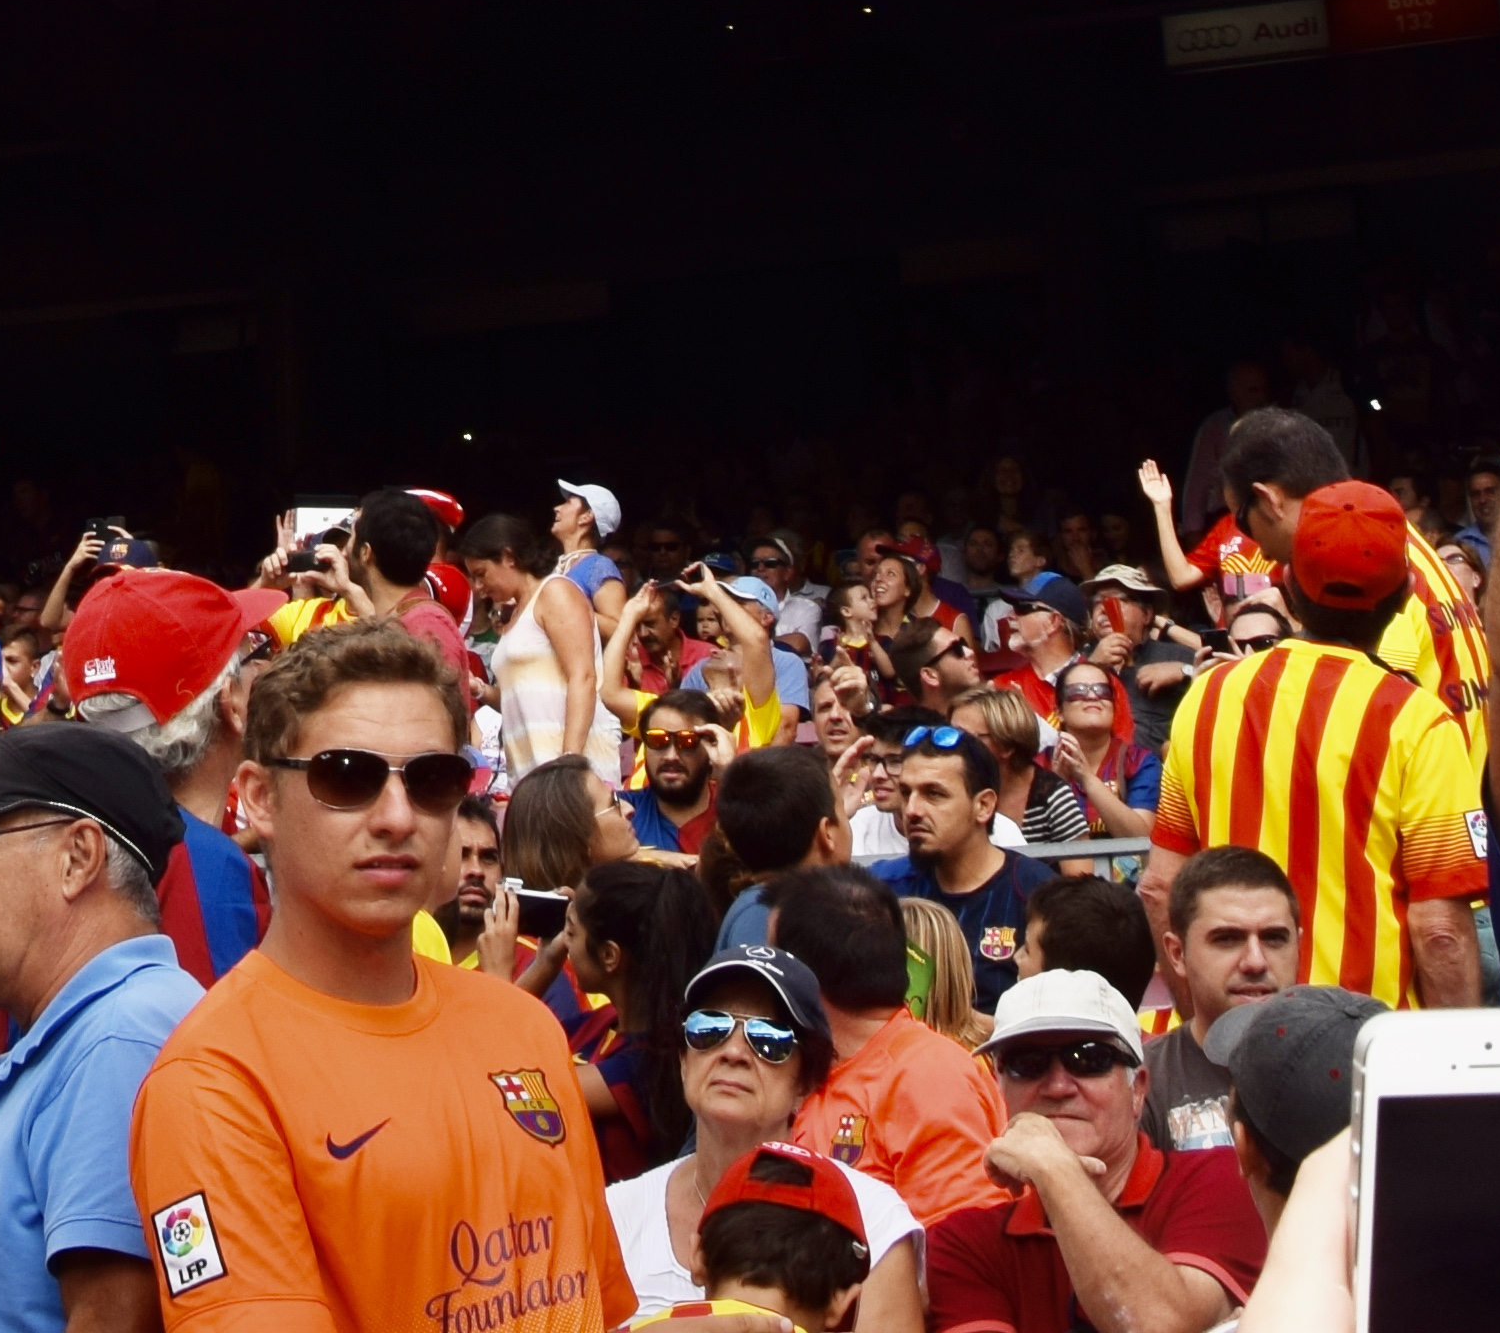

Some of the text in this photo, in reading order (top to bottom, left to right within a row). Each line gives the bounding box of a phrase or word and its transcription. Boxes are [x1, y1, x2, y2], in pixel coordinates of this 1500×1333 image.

[1253, 17, 1319, 42] Audi
[522, 1099, 545, 1110] FCB
[450, 1211, 554, 1288] Qatar
[178, 1258, 208, 1285] LFP
